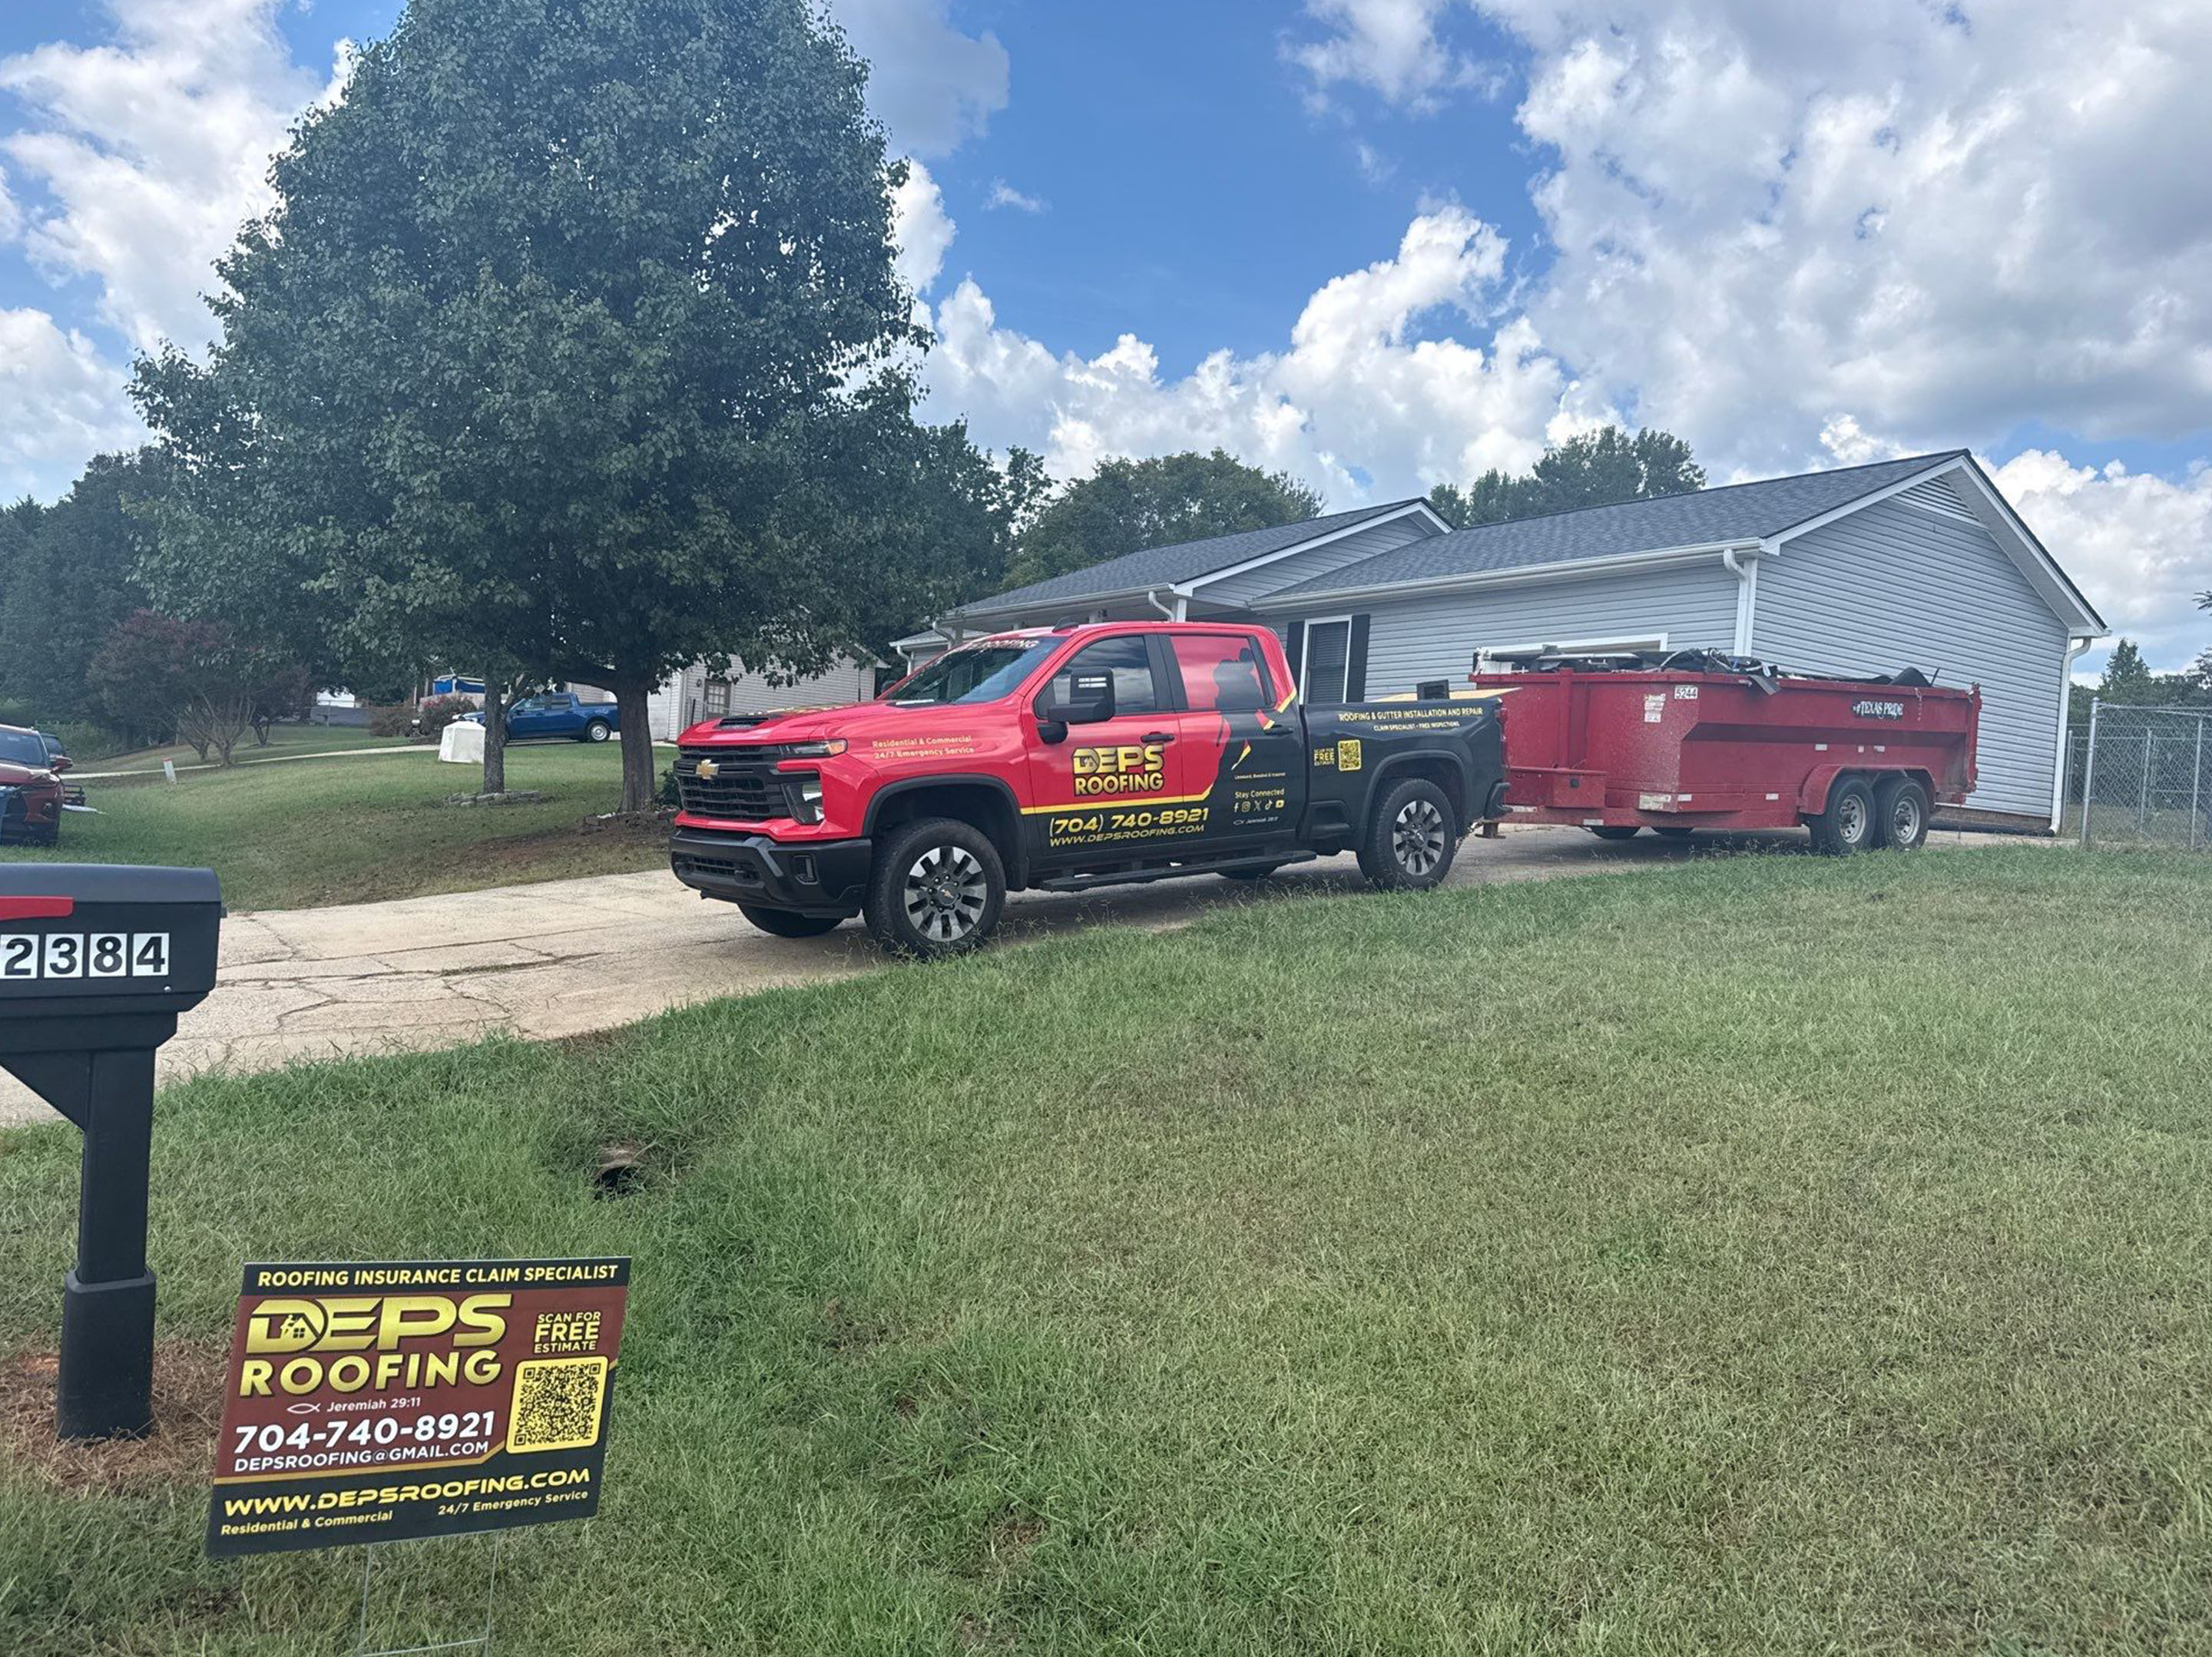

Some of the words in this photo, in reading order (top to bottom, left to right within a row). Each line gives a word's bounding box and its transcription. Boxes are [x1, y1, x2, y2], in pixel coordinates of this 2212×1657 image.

[1676, 688, 1697, 699] 5244
[1339, 711, 1371, 722] ROOFING
[1372, 711, 1376, 720] &
[1377, 710, 1402, 719] GUTTER
[1403, 709, 1447, 719] INSTALLATION
[1462, 707, 1484, 716] REPAIR
[1859, 701, 1883, 717] TEXAS
[873, 739, 917, 748] Residential
[926, 736, 972, 745] Commercial
[874, 751, 894, 759] 24/7
[897, 749, 943, 757] Emergency
[945, 746, 975, 755] Service
[1073, 745, 1164, 774] DEPS
[1314, 752, 1334, 761] FREE
[1075, 772, 1164, 795] ROOFING
[1235, 791, 1249, 799] Stay
[1250, 788, 1285, 798] Connected
[1049, 814, 1104, 837] (704)
[1111, 808, 1209, 828] 740-8921
[1049, 825, 1204, 847] WWW.DEPSROOFING.COM
[5, 936, 165, 976] 2384
[258, 1271, 349, 1287] ROOFING
[354, 1268, 461, 1285] INSURANCE
[465, 1268, 520, 1282] CLAIM
[524, 1265, 618, 1282] SPECIALIST
[246, 1293, 512, 1354] DEPS
[538, 1312, 572, 1324] SCAN
[576, 1311, 601, 1321] FOR
[535, 1321, 601, 1342] FREE
[534, 1341, 597, 1354] ESTIMATE
[239, 1349, 502, 1397] ROOFING
[326, 1399, 386, 1412] Jeremiah
[390, 1397, 421, 1408] 29:11
[234, 1411, 495, 1454] 704-740-8921
[234, 1441, 489, 1472] DEPSROOFING@GMAIL.COM
[224, 1468, 591, 1516] WWW.DEPSROOFING.COM
[438, 1503, 469, 1516] 24/7
[472, 1497, 541, 1512] Emergency
[545, 1490, 588, 1503] Service
[220, 1520, 298, 1536] Residential
[301, 1518, 311, 1529] &
[314, 1510, 393, 1528] Commercial
